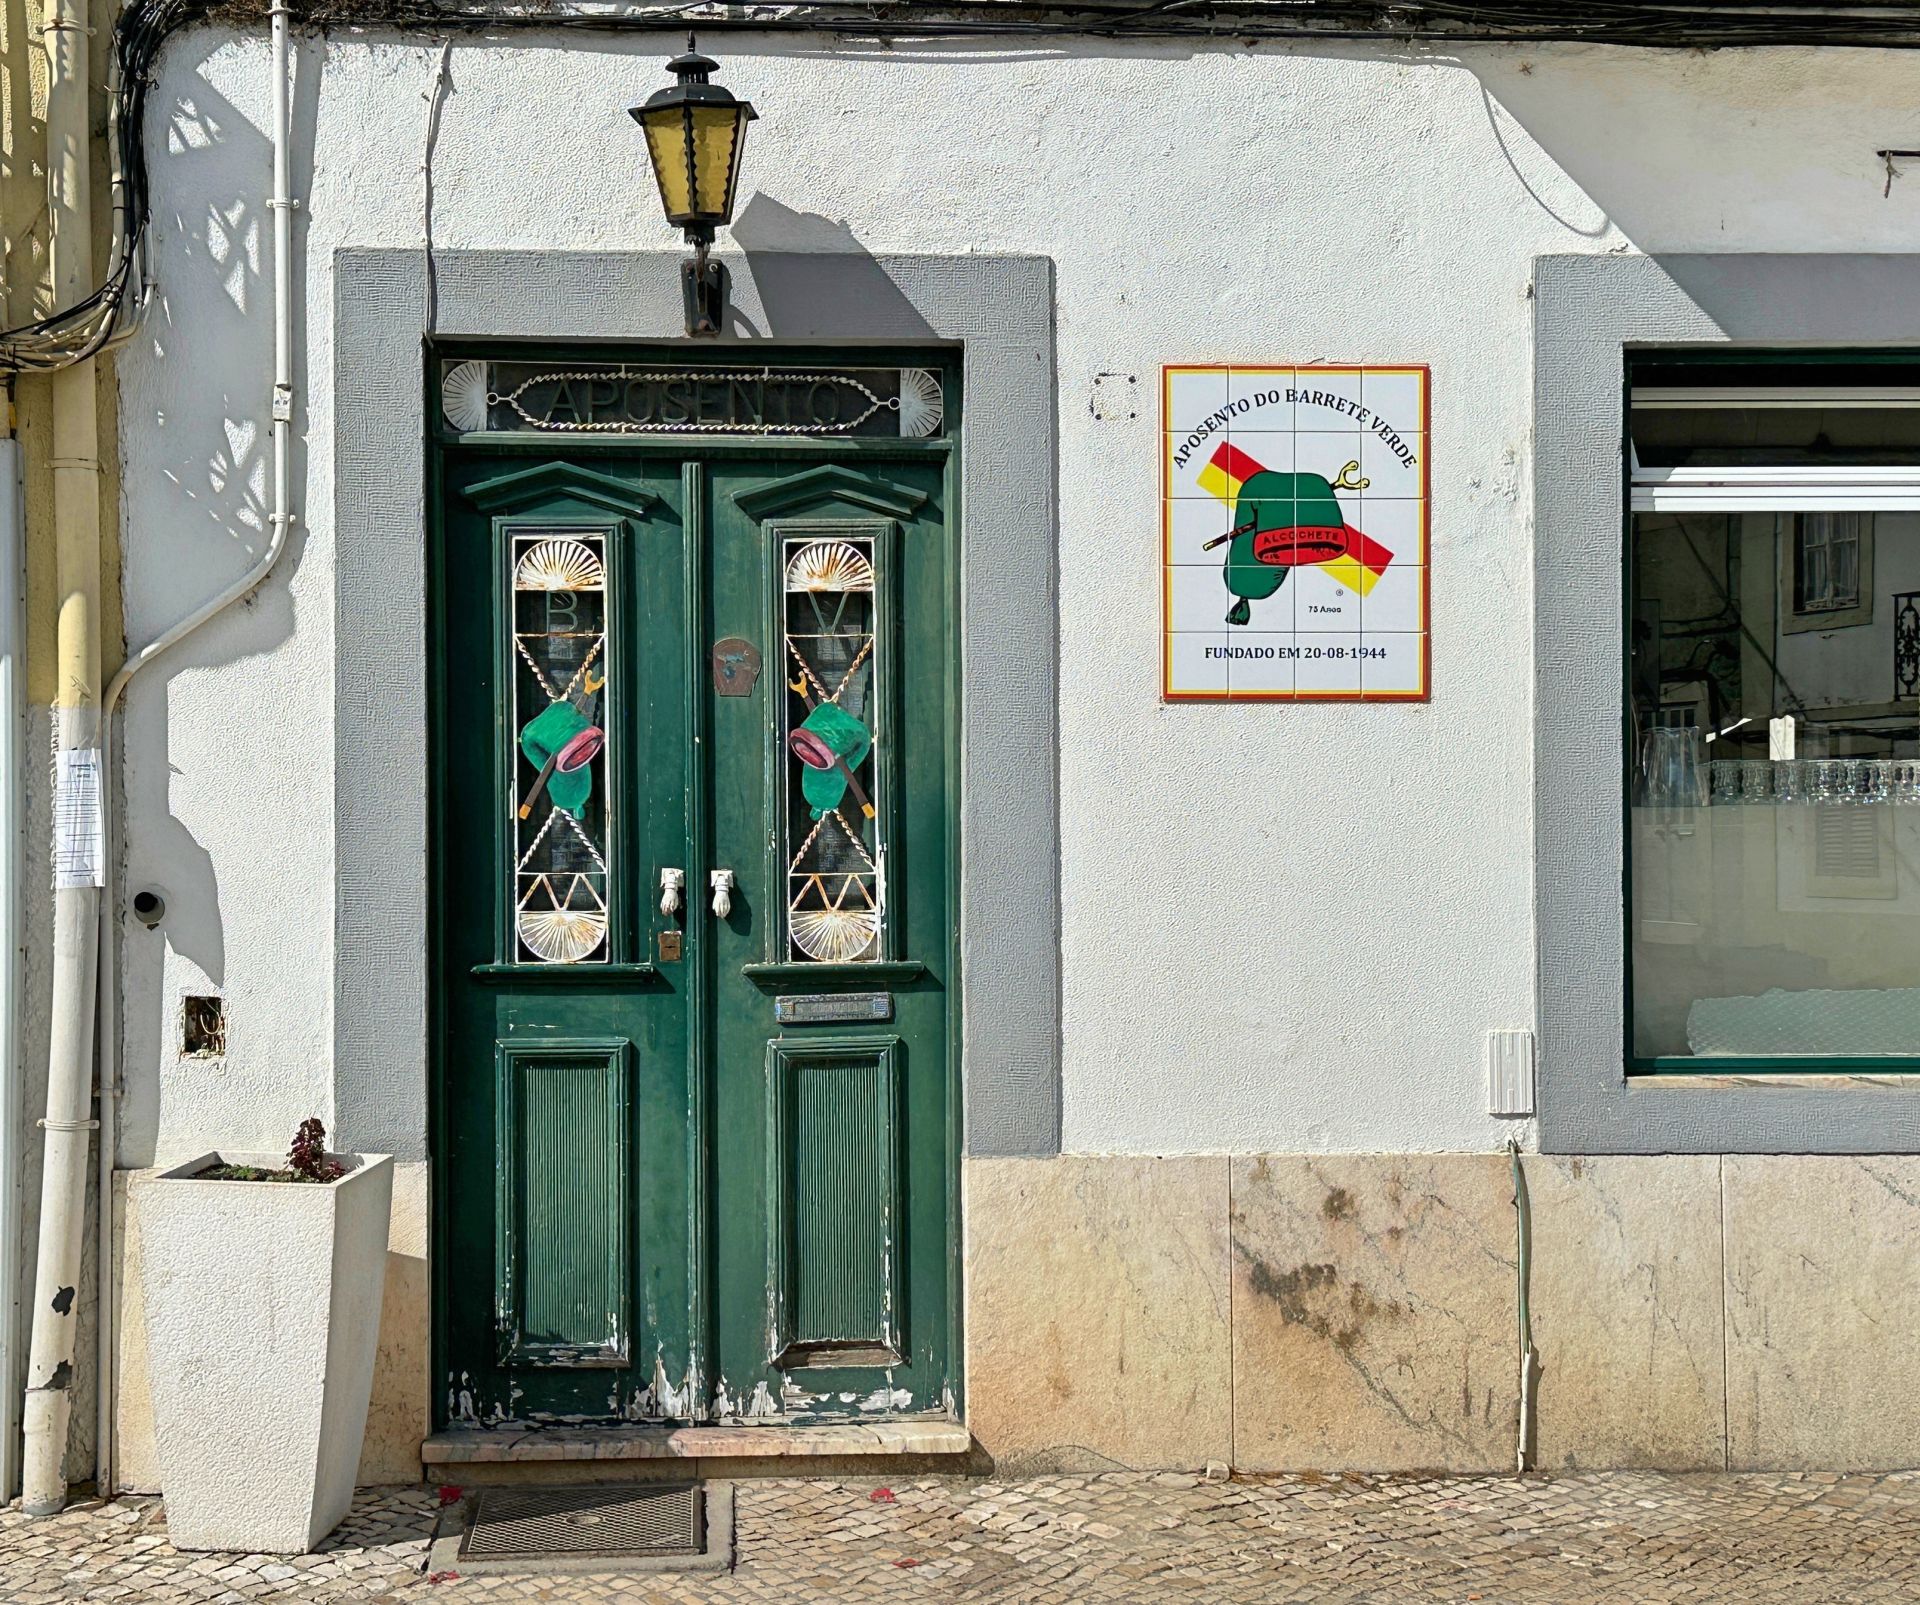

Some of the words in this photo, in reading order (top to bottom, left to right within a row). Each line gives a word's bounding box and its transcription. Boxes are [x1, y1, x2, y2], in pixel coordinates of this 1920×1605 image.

[543, 376, 841, 426] APOSENTO
[1172, 398, 1250, 470] APOSENTO
[1253, 388, 1280, 408] DO
[1286, 388, 1370, 423] BARRETE
[1371, 415, 1418, 470] VERDE
[1263, 530, 1339, 545] ALCOCHETE
[1308, 605, 1319, 613] 75
[1204, 647, 1275, 660] FUNDADO
[1278, 647, 1300, 660] EM
[1304, 647, 1387, 660] 20-08-1944
